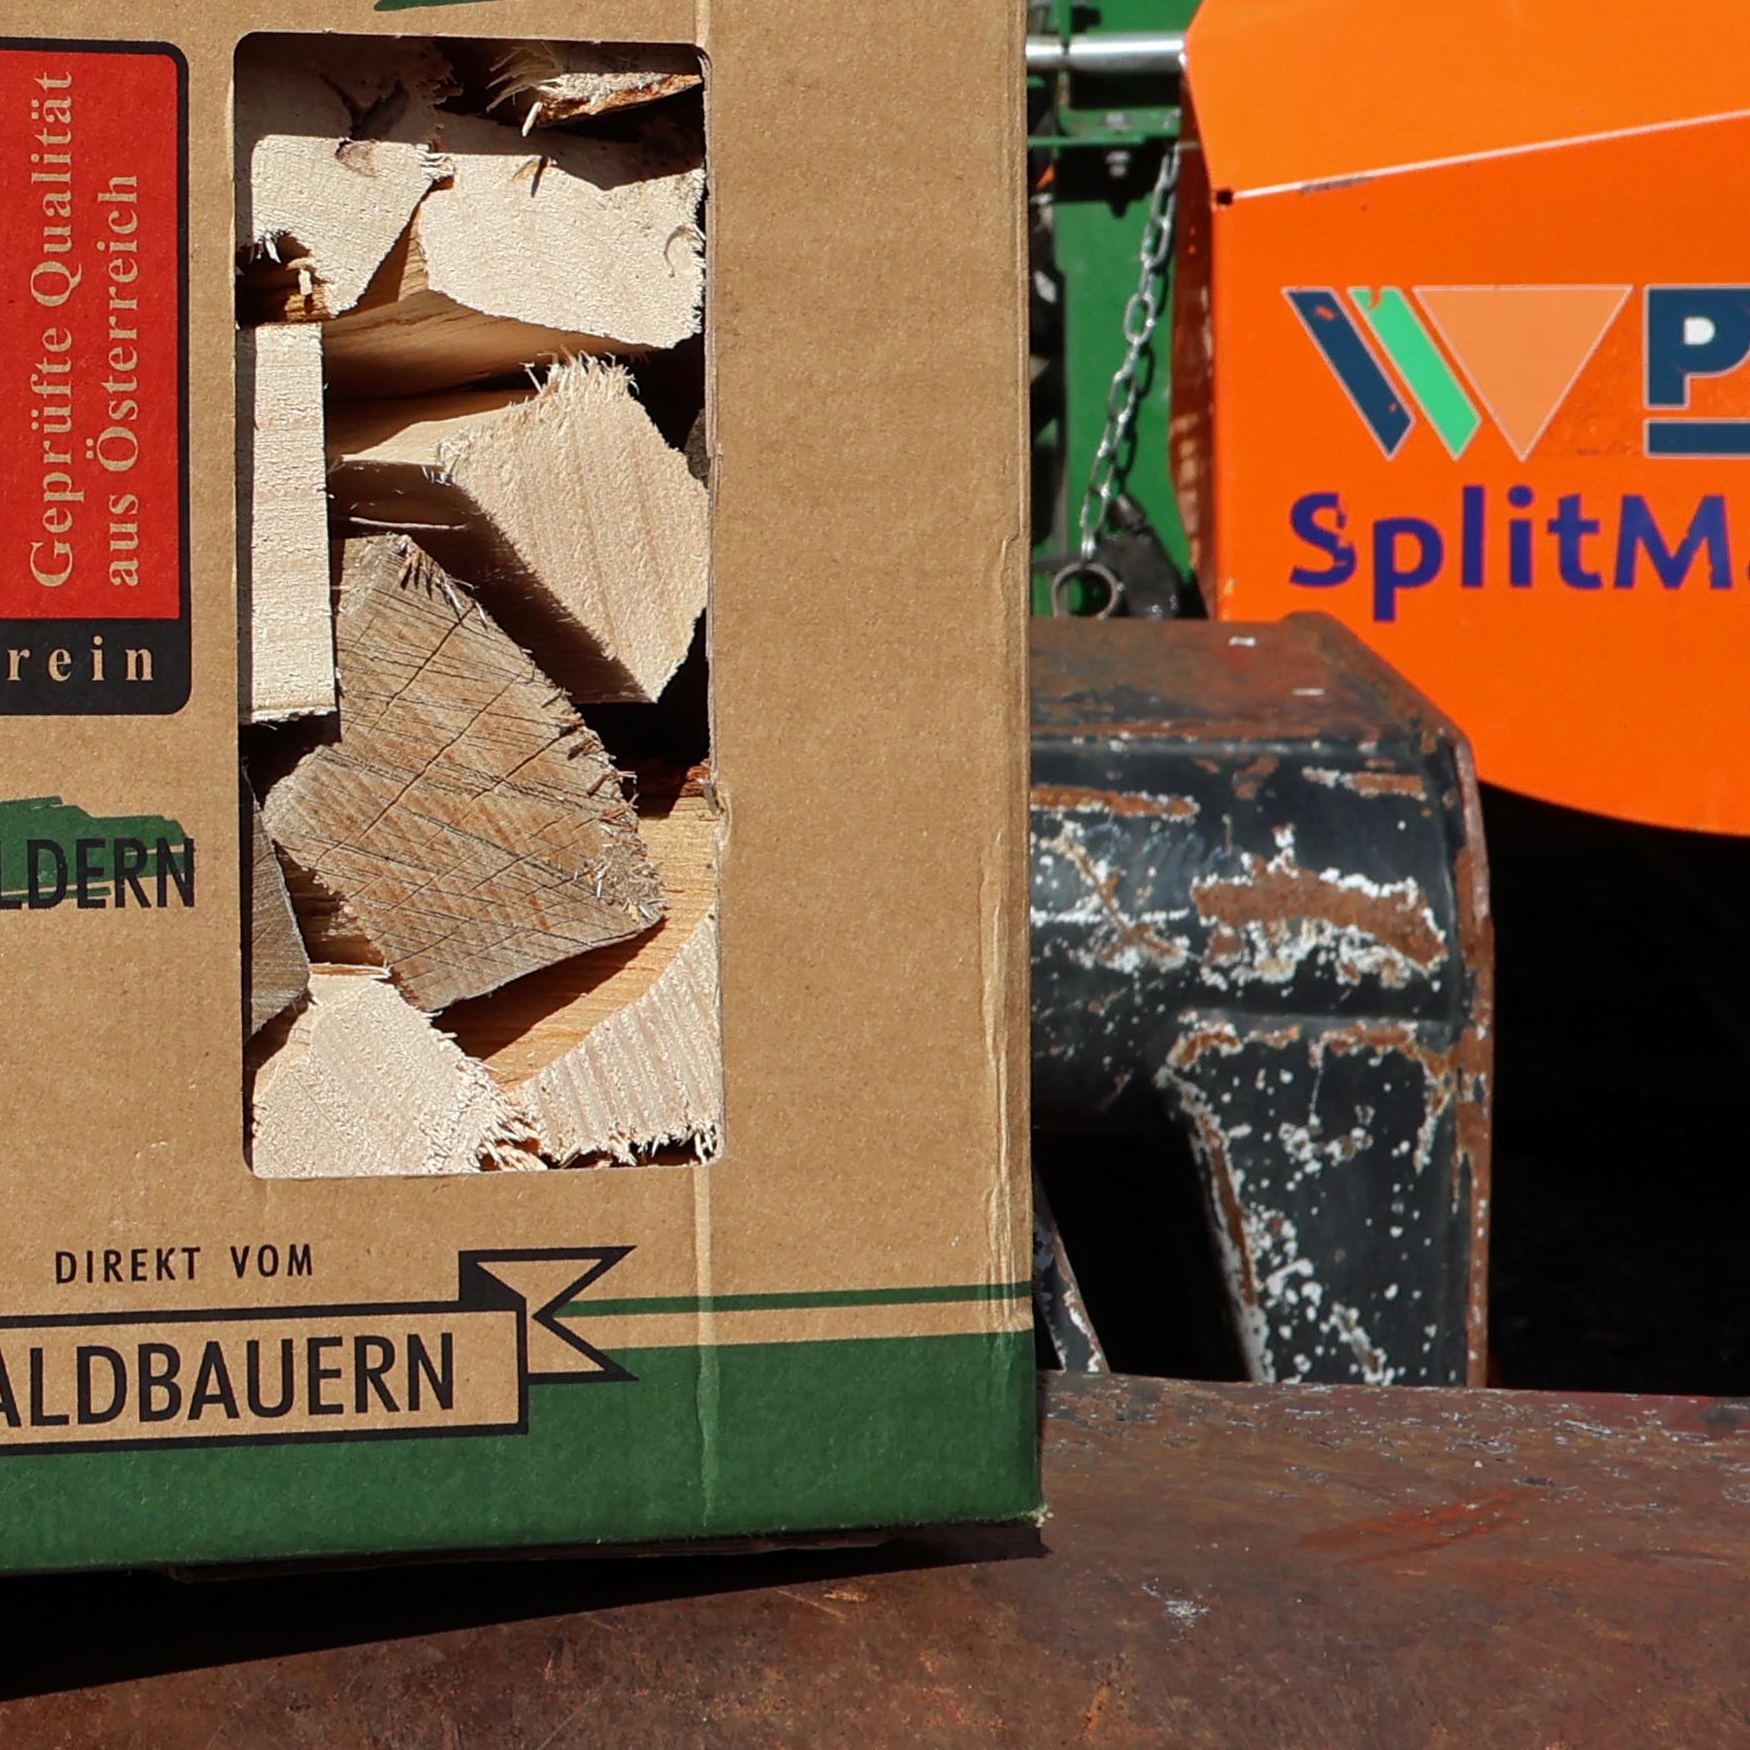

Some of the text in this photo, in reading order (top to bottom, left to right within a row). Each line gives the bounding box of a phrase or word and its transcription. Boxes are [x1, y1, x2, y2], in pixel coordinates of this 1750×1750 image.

[29, 70, 86, 588] Geprüfte Qualität
[83, 172, 141, 588] aus Österreich
[1289, 484, 1750, 624] SplitM
[54, 1242, 315, 1286] DIREKT VOM
